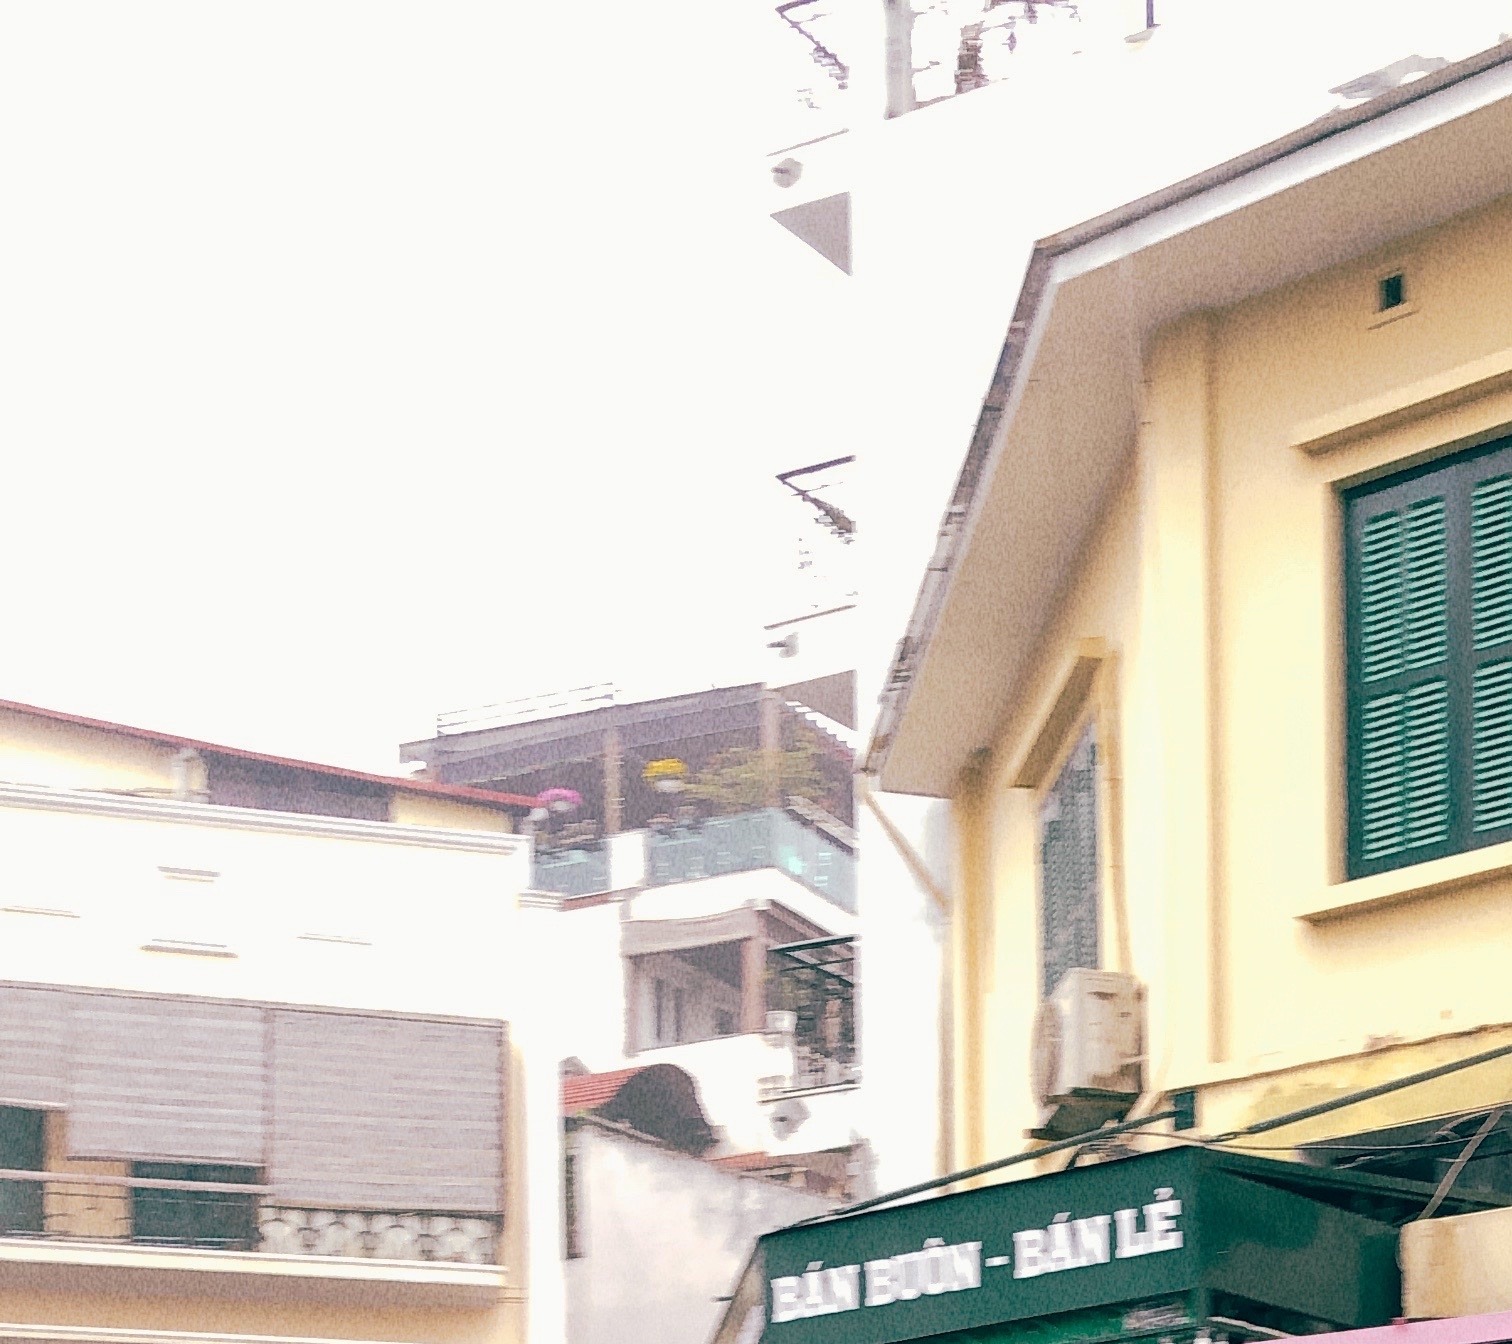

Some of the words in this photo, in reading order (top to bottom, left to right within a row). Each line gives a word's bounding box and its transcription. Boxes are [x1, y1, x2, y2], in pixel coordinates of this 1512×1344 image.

[770, 1260, 861, 1323] BÁN
[864, 1237, 983, 1307] BUÔN
[1012, 1211, 1112, 1279] BÁN
[1114, 1187, 1184, 1259] LẺ
